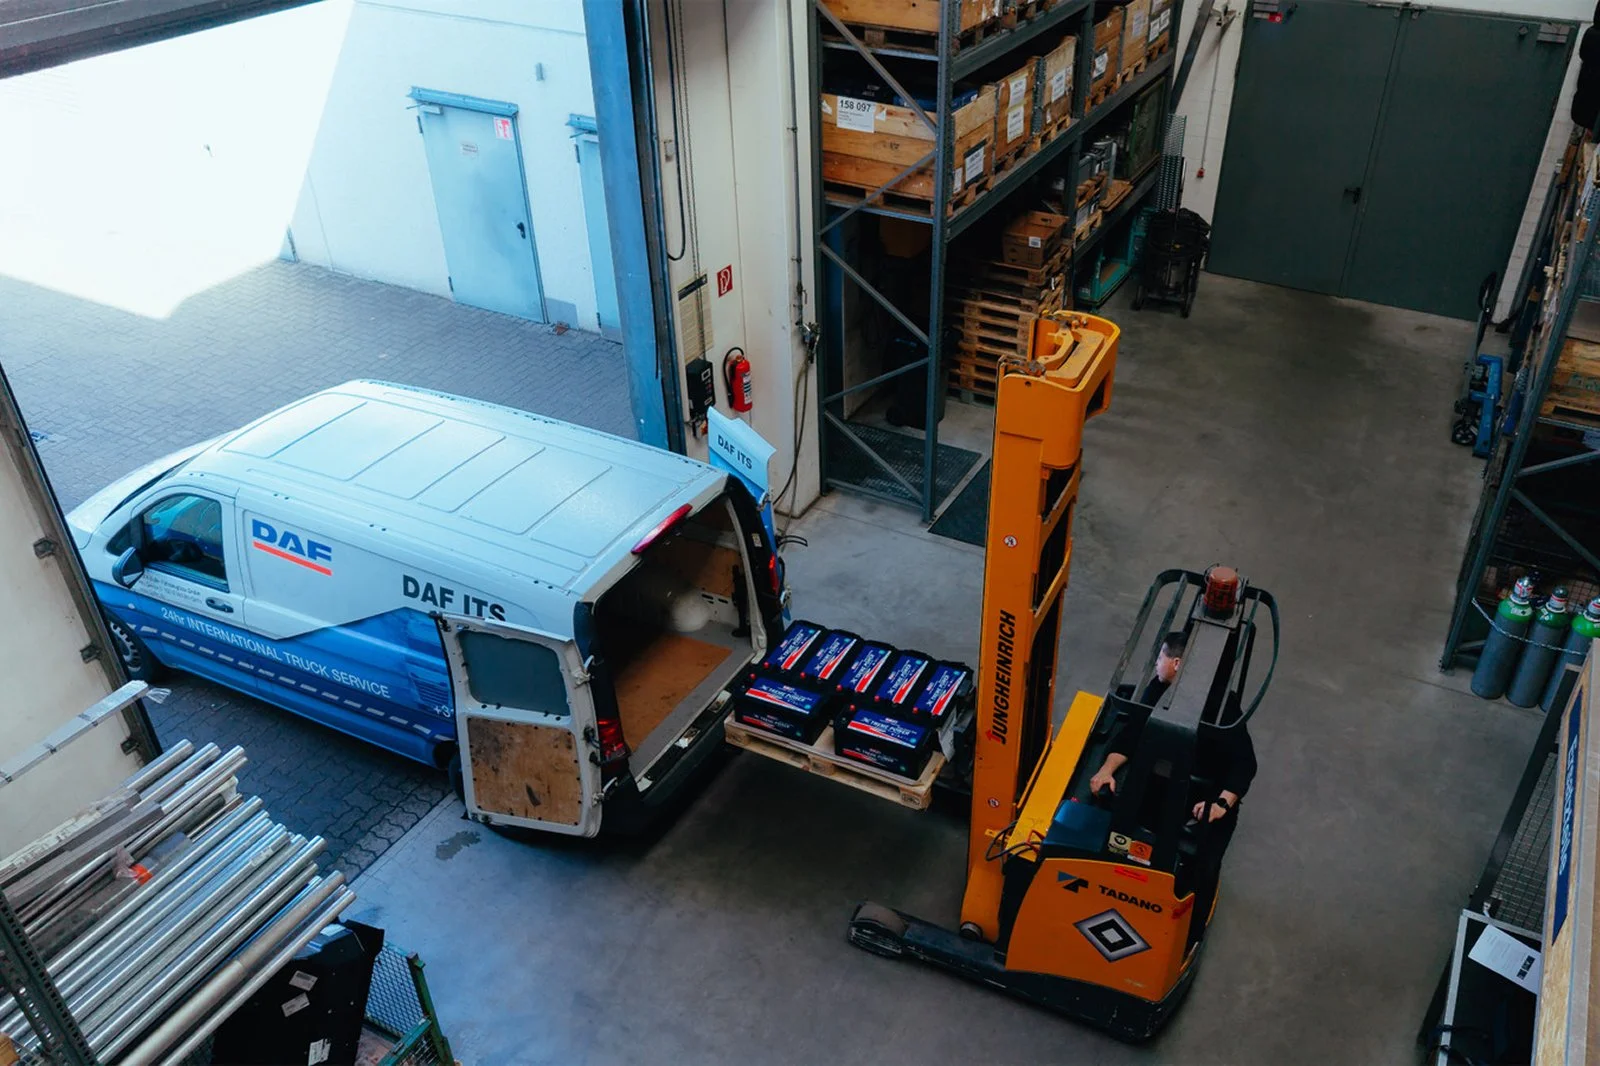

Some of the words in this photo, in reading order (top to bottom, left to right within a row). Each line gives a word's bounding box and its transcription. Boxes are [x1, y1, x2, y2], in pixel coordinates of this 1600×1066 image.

[840, 99, 855, 110] 158
[856, 102, 873, 112] 097
[717, 434, 736, 456] DAF
[737, 450, 753, 470] ITS
[252, 518, 333, 562] DAF
[402, 574, 454, 609] DAF
[463, 593, 506, 622] ITS
[160, 606, 185, 626] 24hr
[187, 616, 283, 662] INTERNATIONAL
[283, 650, 330, 679] TRUCK
[331, 668, 392, 699] SERVICE
[991, 609, 1016, 745] JUNGHEINRICH
[433, 704, 455, 718] +3
[1098, 885, 1163, 914] TADANO
